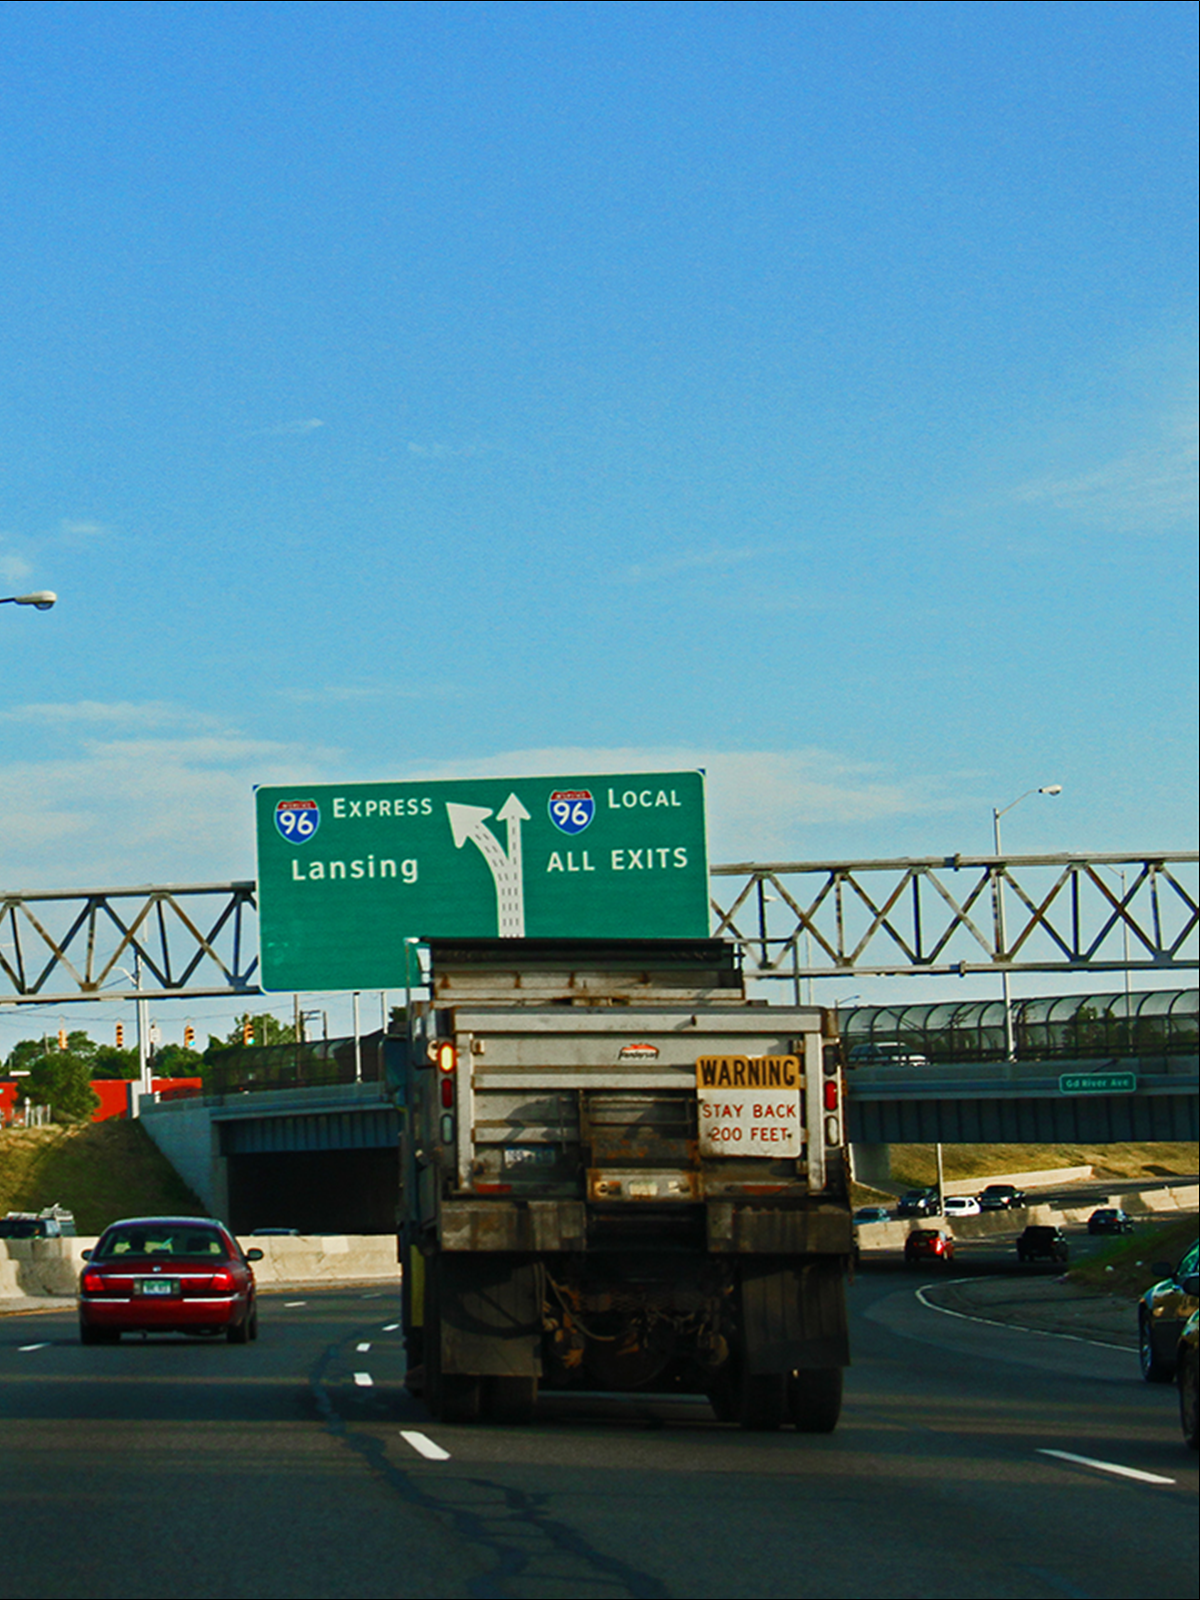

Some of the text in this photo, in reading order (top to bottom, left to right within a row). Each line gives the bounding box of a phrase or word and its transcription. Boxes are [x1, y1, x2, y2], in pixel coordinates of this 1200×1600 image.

[280, 797, 433, 835] 96 EXPRESS
[554, 788, 682, 826] 96 LOCAL
[292, 854, 418, 884] Lansing
[546, 847, 688, 872] ALL EXITS
[700, 1059, 796, 1087] WARNING
[702, 1103, 797, 1119] STAY BACK
[711, 1126, 788, 1142] 200 FEET
